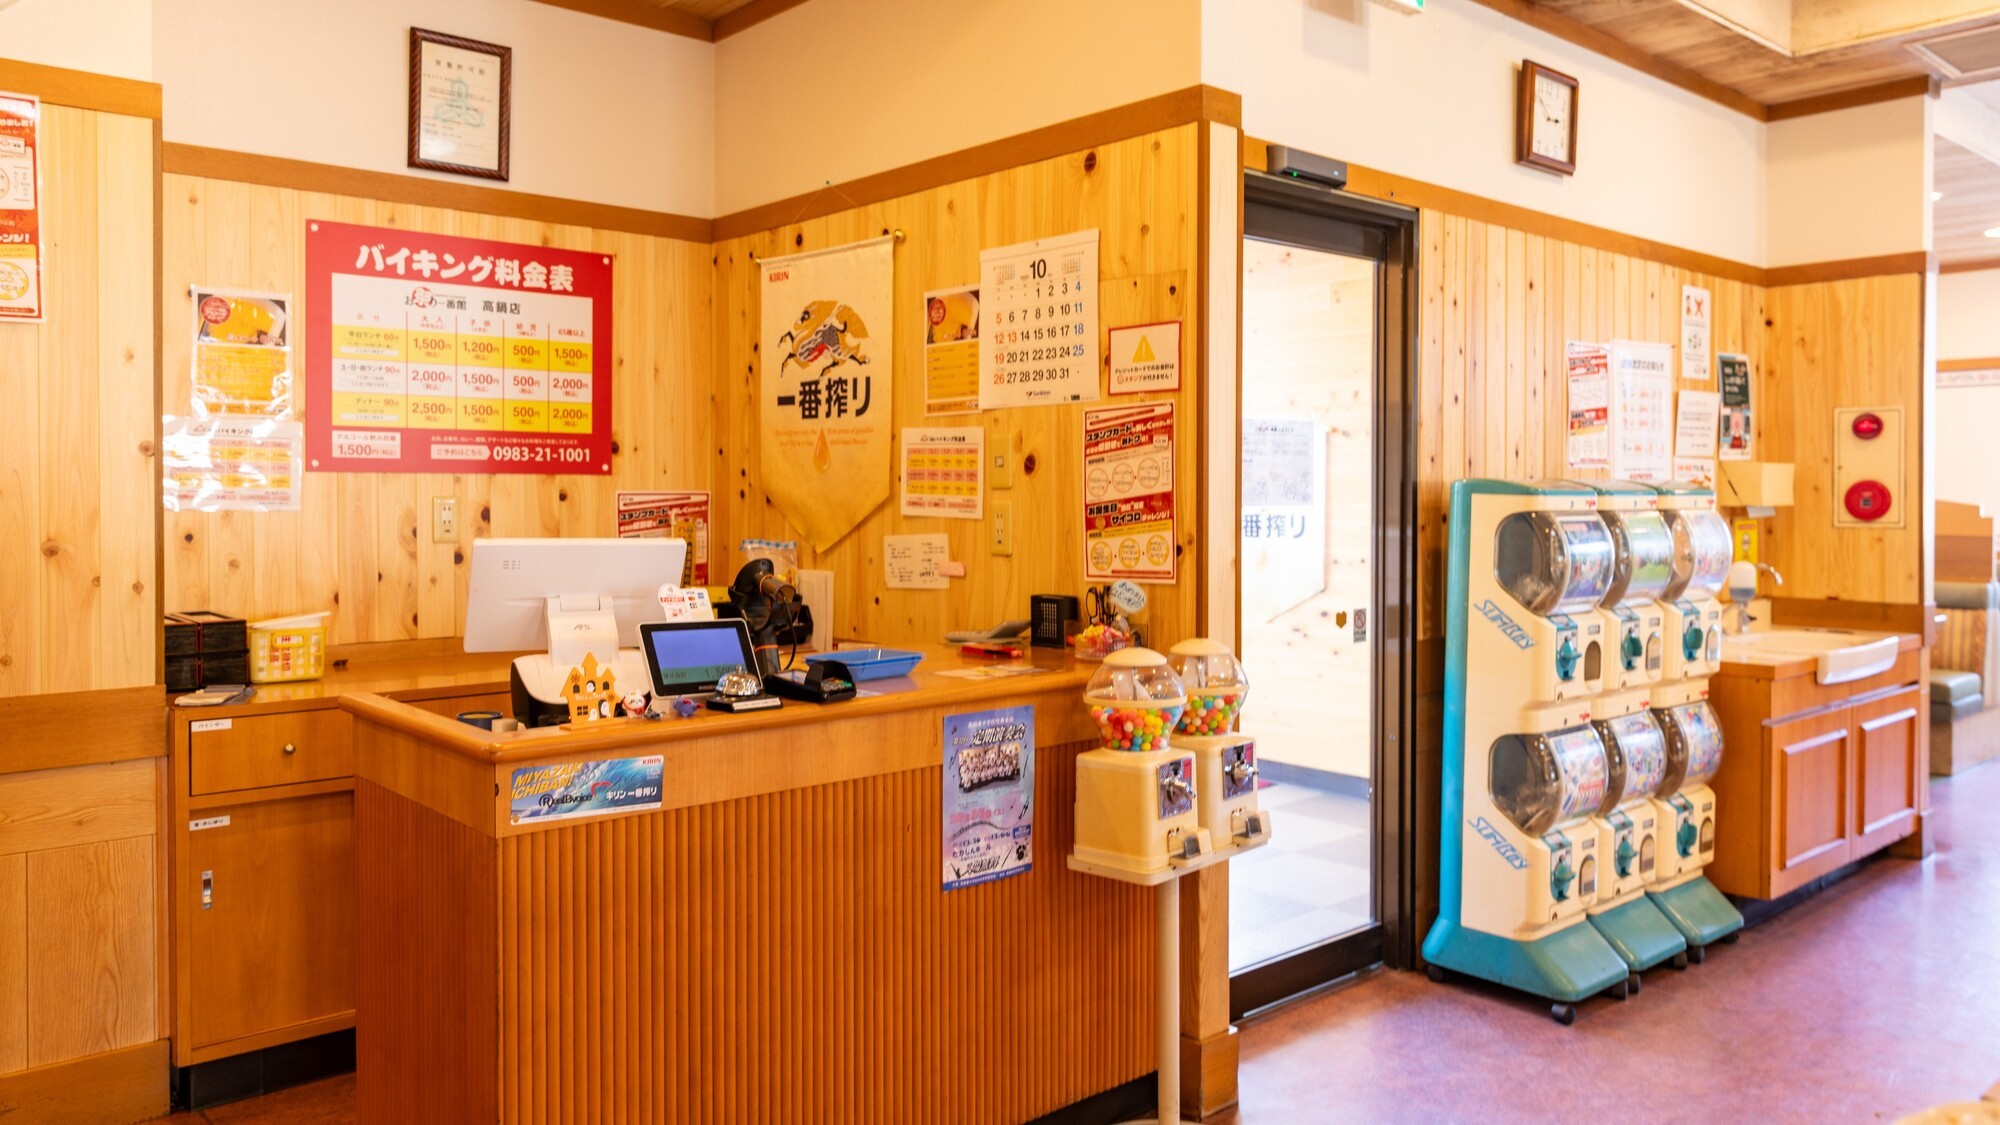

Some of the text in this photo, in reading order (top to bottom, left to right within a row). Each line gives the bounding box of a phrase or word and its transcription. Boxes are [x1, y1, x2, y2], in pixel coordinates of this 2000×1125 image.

[356, 244, 574, 292] バイキング料金表
[769, 271, 789, 283] KIRIN
[1030, 259, 1046, 279] 10
[1036, 281, 1081, 298] 1 2 3 4
[482, 300, 521, 315] 高鍋店
[996, 302, 1082, 325] 5 6 7 8 9 10 11
[994, 323, 1084, 344] 12 13 14 15 16 17 18
[414, 338, 452, 351] 1,500円
[463, 342, 500, 354] 1,200円
[513, 345, 541, 356] 500円
[554, 348, 588, 360] 1,500円
[995, 344, 1084, 364] 19 20 21 22 23 24 25
[994, 368, 1069, 385] 26 27 28 29 30 31
[1115, 363, 1174, 374] クレジットカードでのお会計は
[412, 370, 452, 383] 2,000円
[463, 373, 500, 385] 1,500円
[513, 375, 541, 387] 500円
[553, 378, 588, 390] 2,000円
[777, 376, 871, 419] 一番搾り
[412, 402, 452, 415] 2,500円
[463, 404, 500, 417] 1,500円
[513, 407, 541, 418] 500円
[553, 408, 588, 420] 2,000円
[493, 446, 591, 462] 0983-21-1001
[972, 722, 1027, 746] 定期演奏会
[514, 762, 584, 788] MIYAZAKI
[606, 786, 657, 800] キリン 一番搾り
